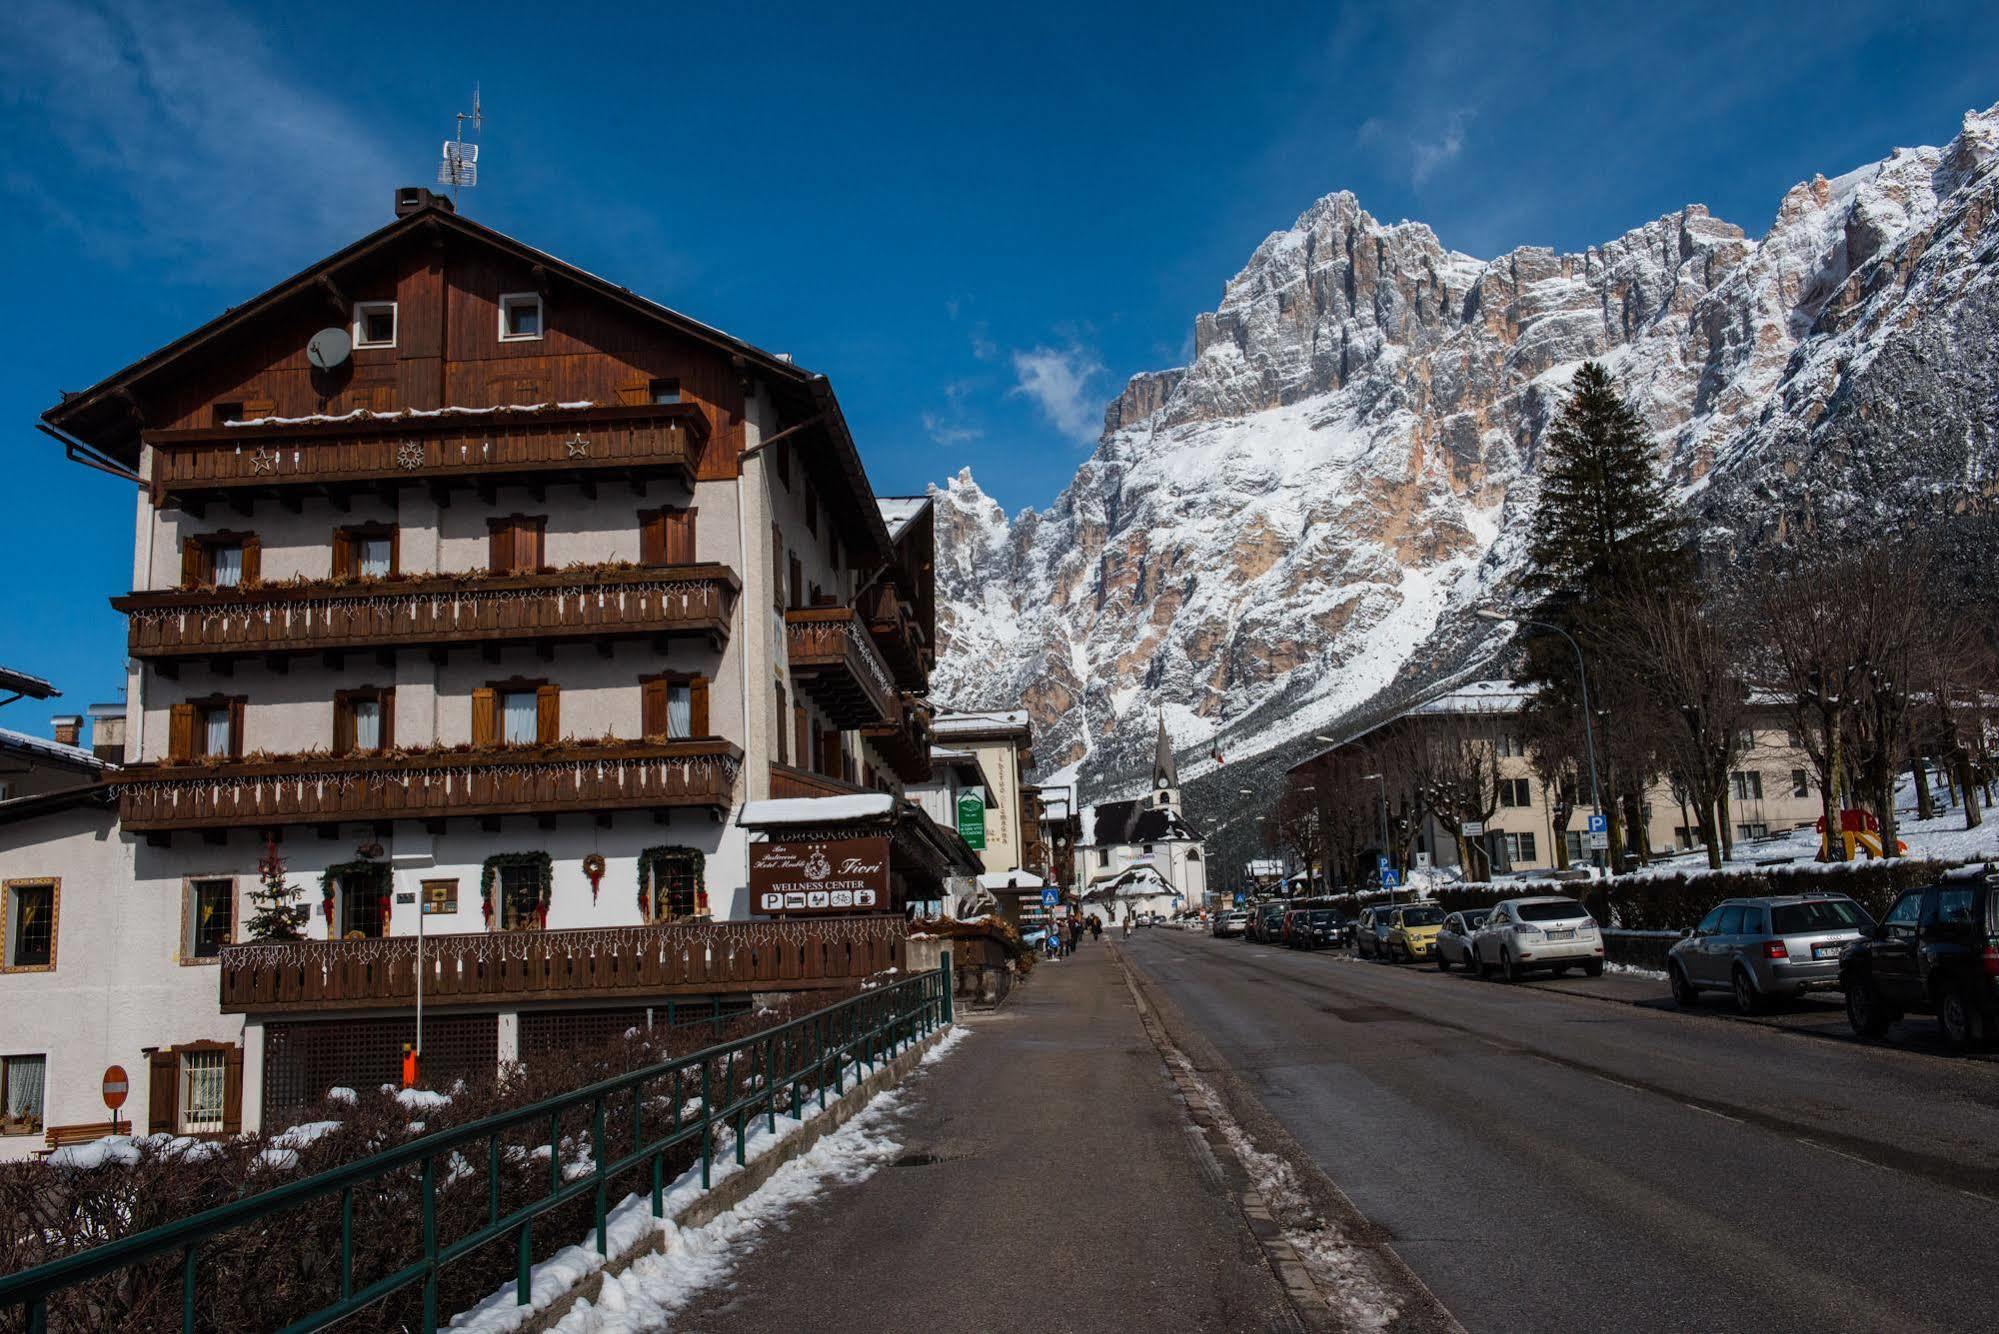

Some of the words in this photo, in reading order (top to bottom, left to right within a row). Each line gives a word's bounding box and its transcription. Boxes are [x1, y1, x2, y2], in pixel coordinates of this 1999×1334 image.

[1592, 816, 1603, 831] P
[753, 860, 778, 869] Hotel
[837, 858, 883, 875] Fiori
[1381, 858, 1388, 867] P
[772, 882, 823, 892] WELLNESS
[825, 880, 864, 890] CENTER
[768, 894, 778, 908] P
